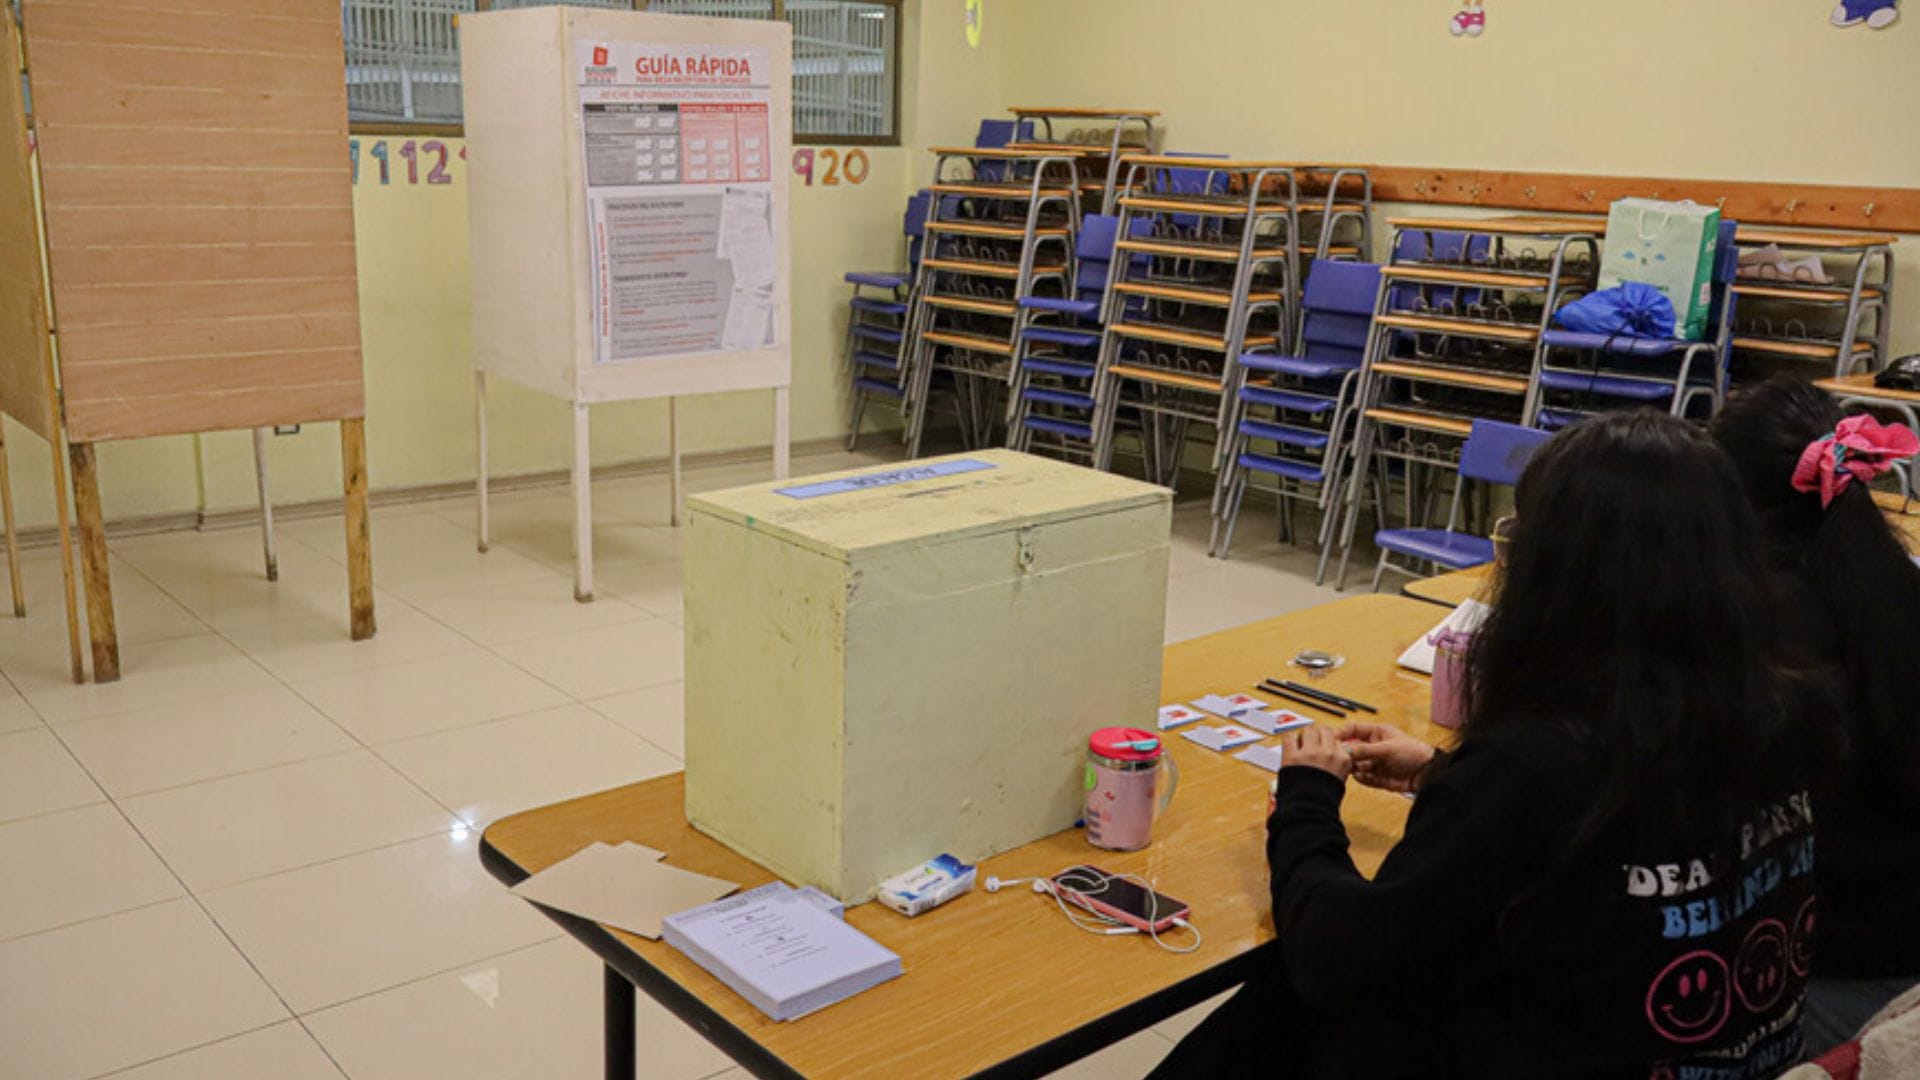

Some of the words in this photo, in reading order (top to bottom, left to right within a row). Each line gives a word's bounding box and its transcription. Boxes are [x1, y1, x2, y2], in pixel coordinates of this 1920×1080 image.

[635, 54, 682, 75] GUÍA
[686, 54, 752, 76] RÁPIDA
[1623, 858, 1712, 897] DEA
